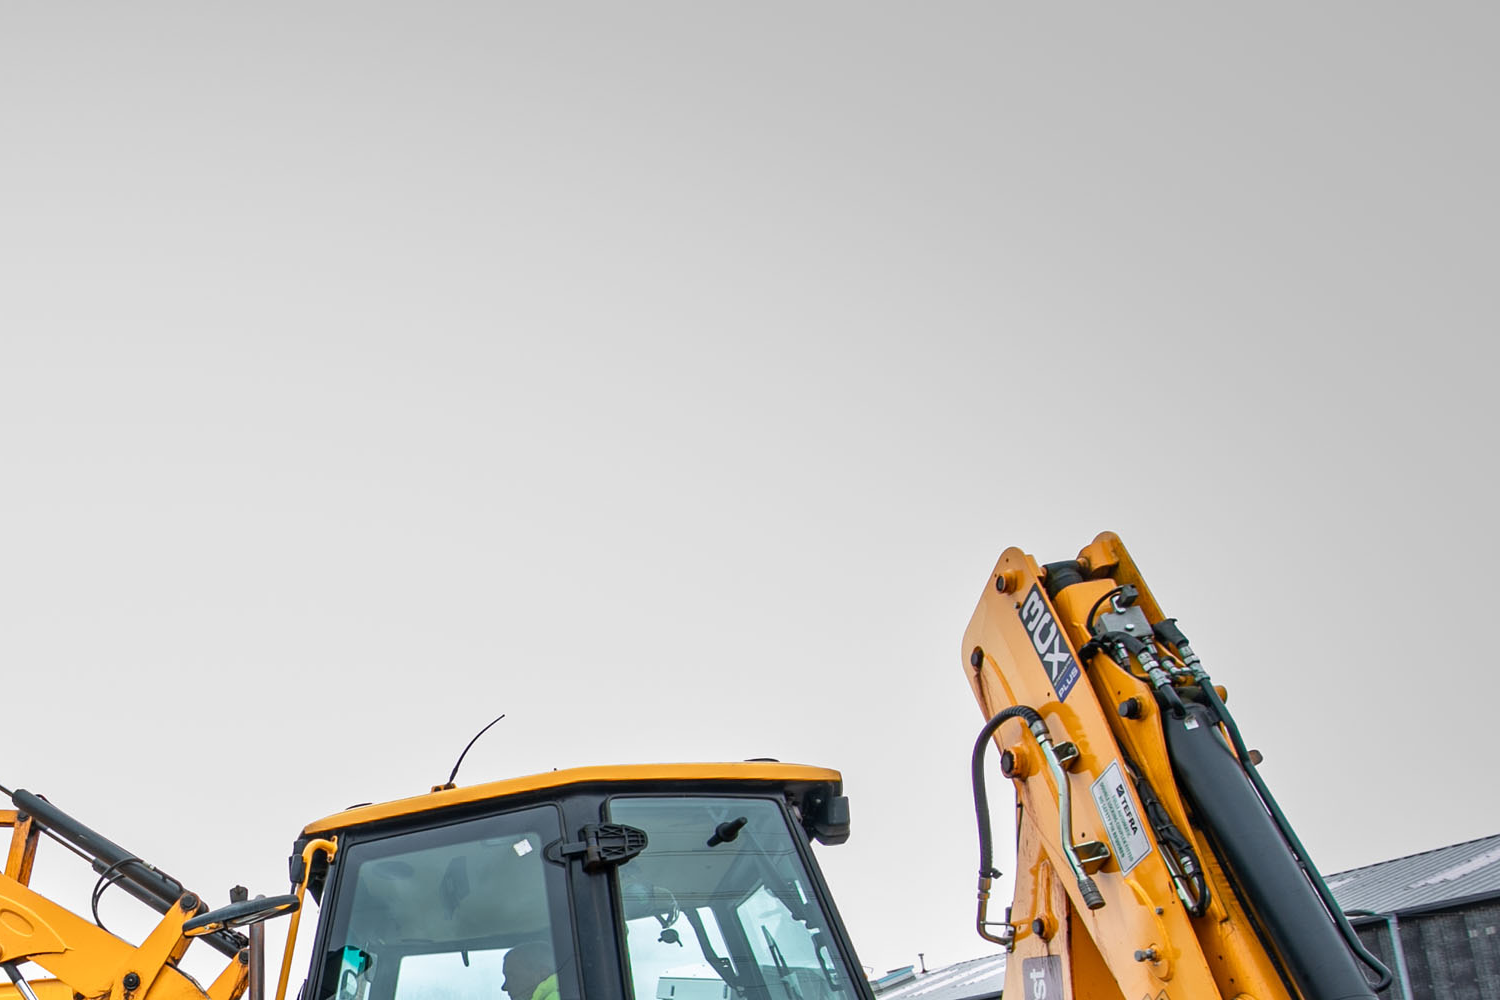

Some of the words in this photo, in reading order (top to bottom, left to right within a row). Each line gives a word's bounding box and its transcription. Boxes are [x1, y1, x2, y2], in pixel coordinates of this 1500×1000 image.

[1022, 590, 1071, 682] 3CX
[1058, 666, 1079, 698] PLUS
[1120, 797, 1138, 836] TEFRA
